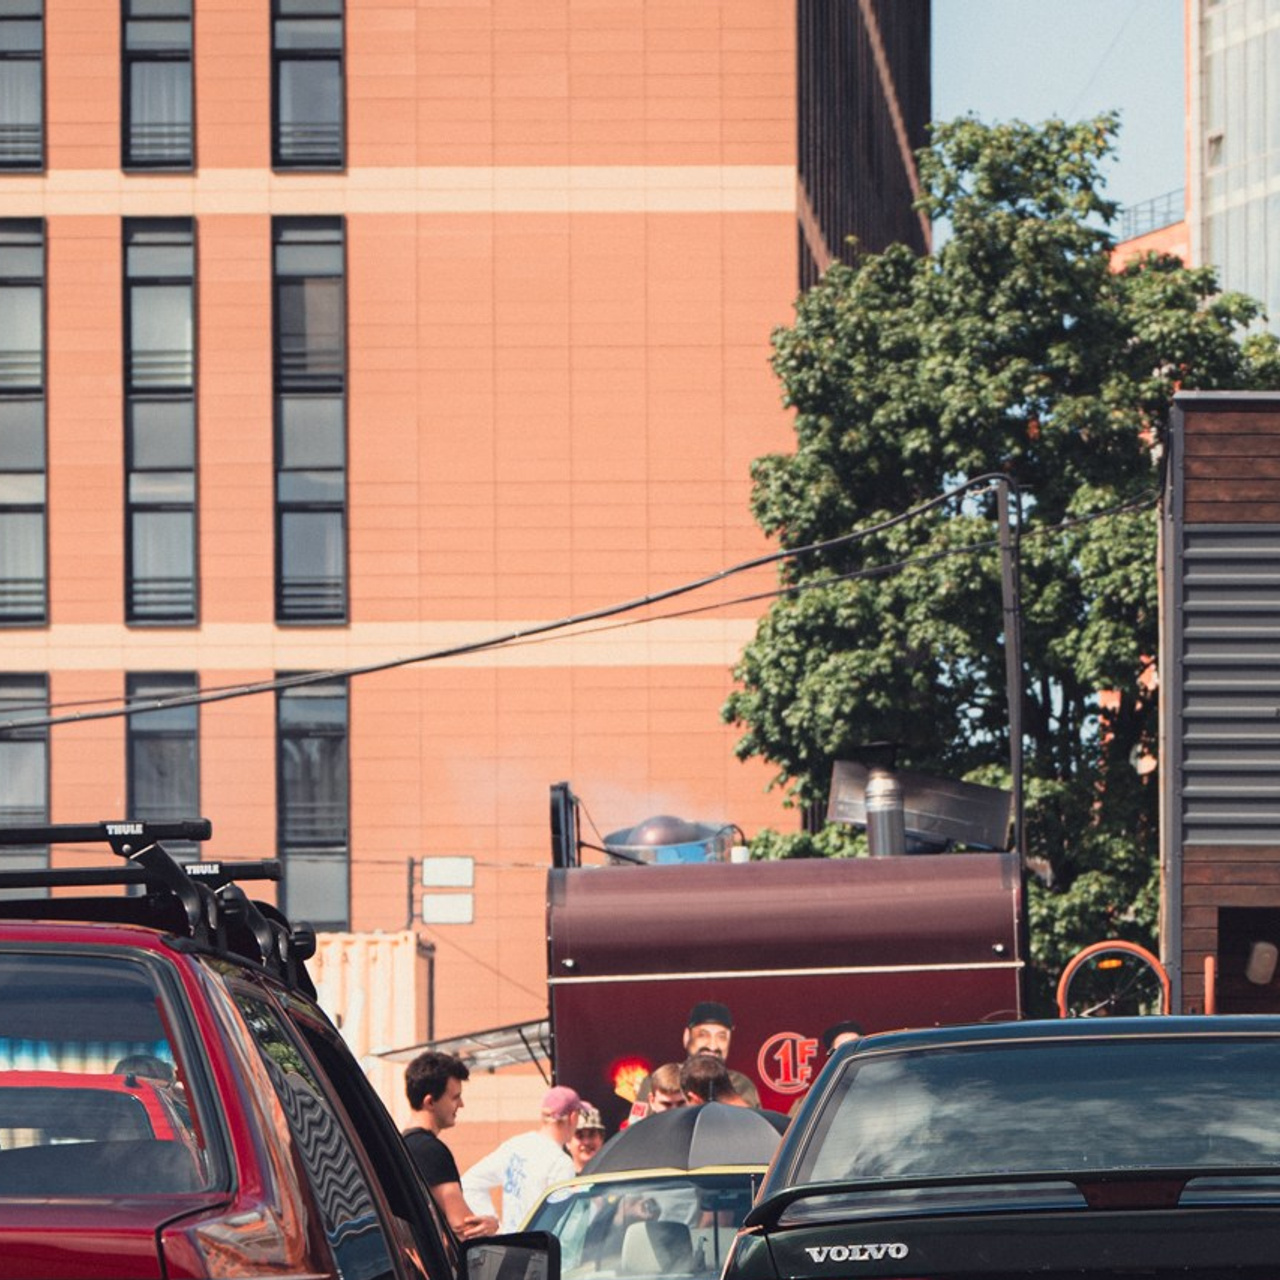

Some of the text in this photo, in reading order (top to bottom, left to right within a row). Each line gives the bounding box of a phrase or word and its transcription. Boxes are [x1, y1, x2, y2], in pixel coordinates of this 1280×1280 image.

[106, 823, 143, 835] THULE
[185, 864, 219, 875] THULE
[804, 1243, 909, 1263] VOLVO
